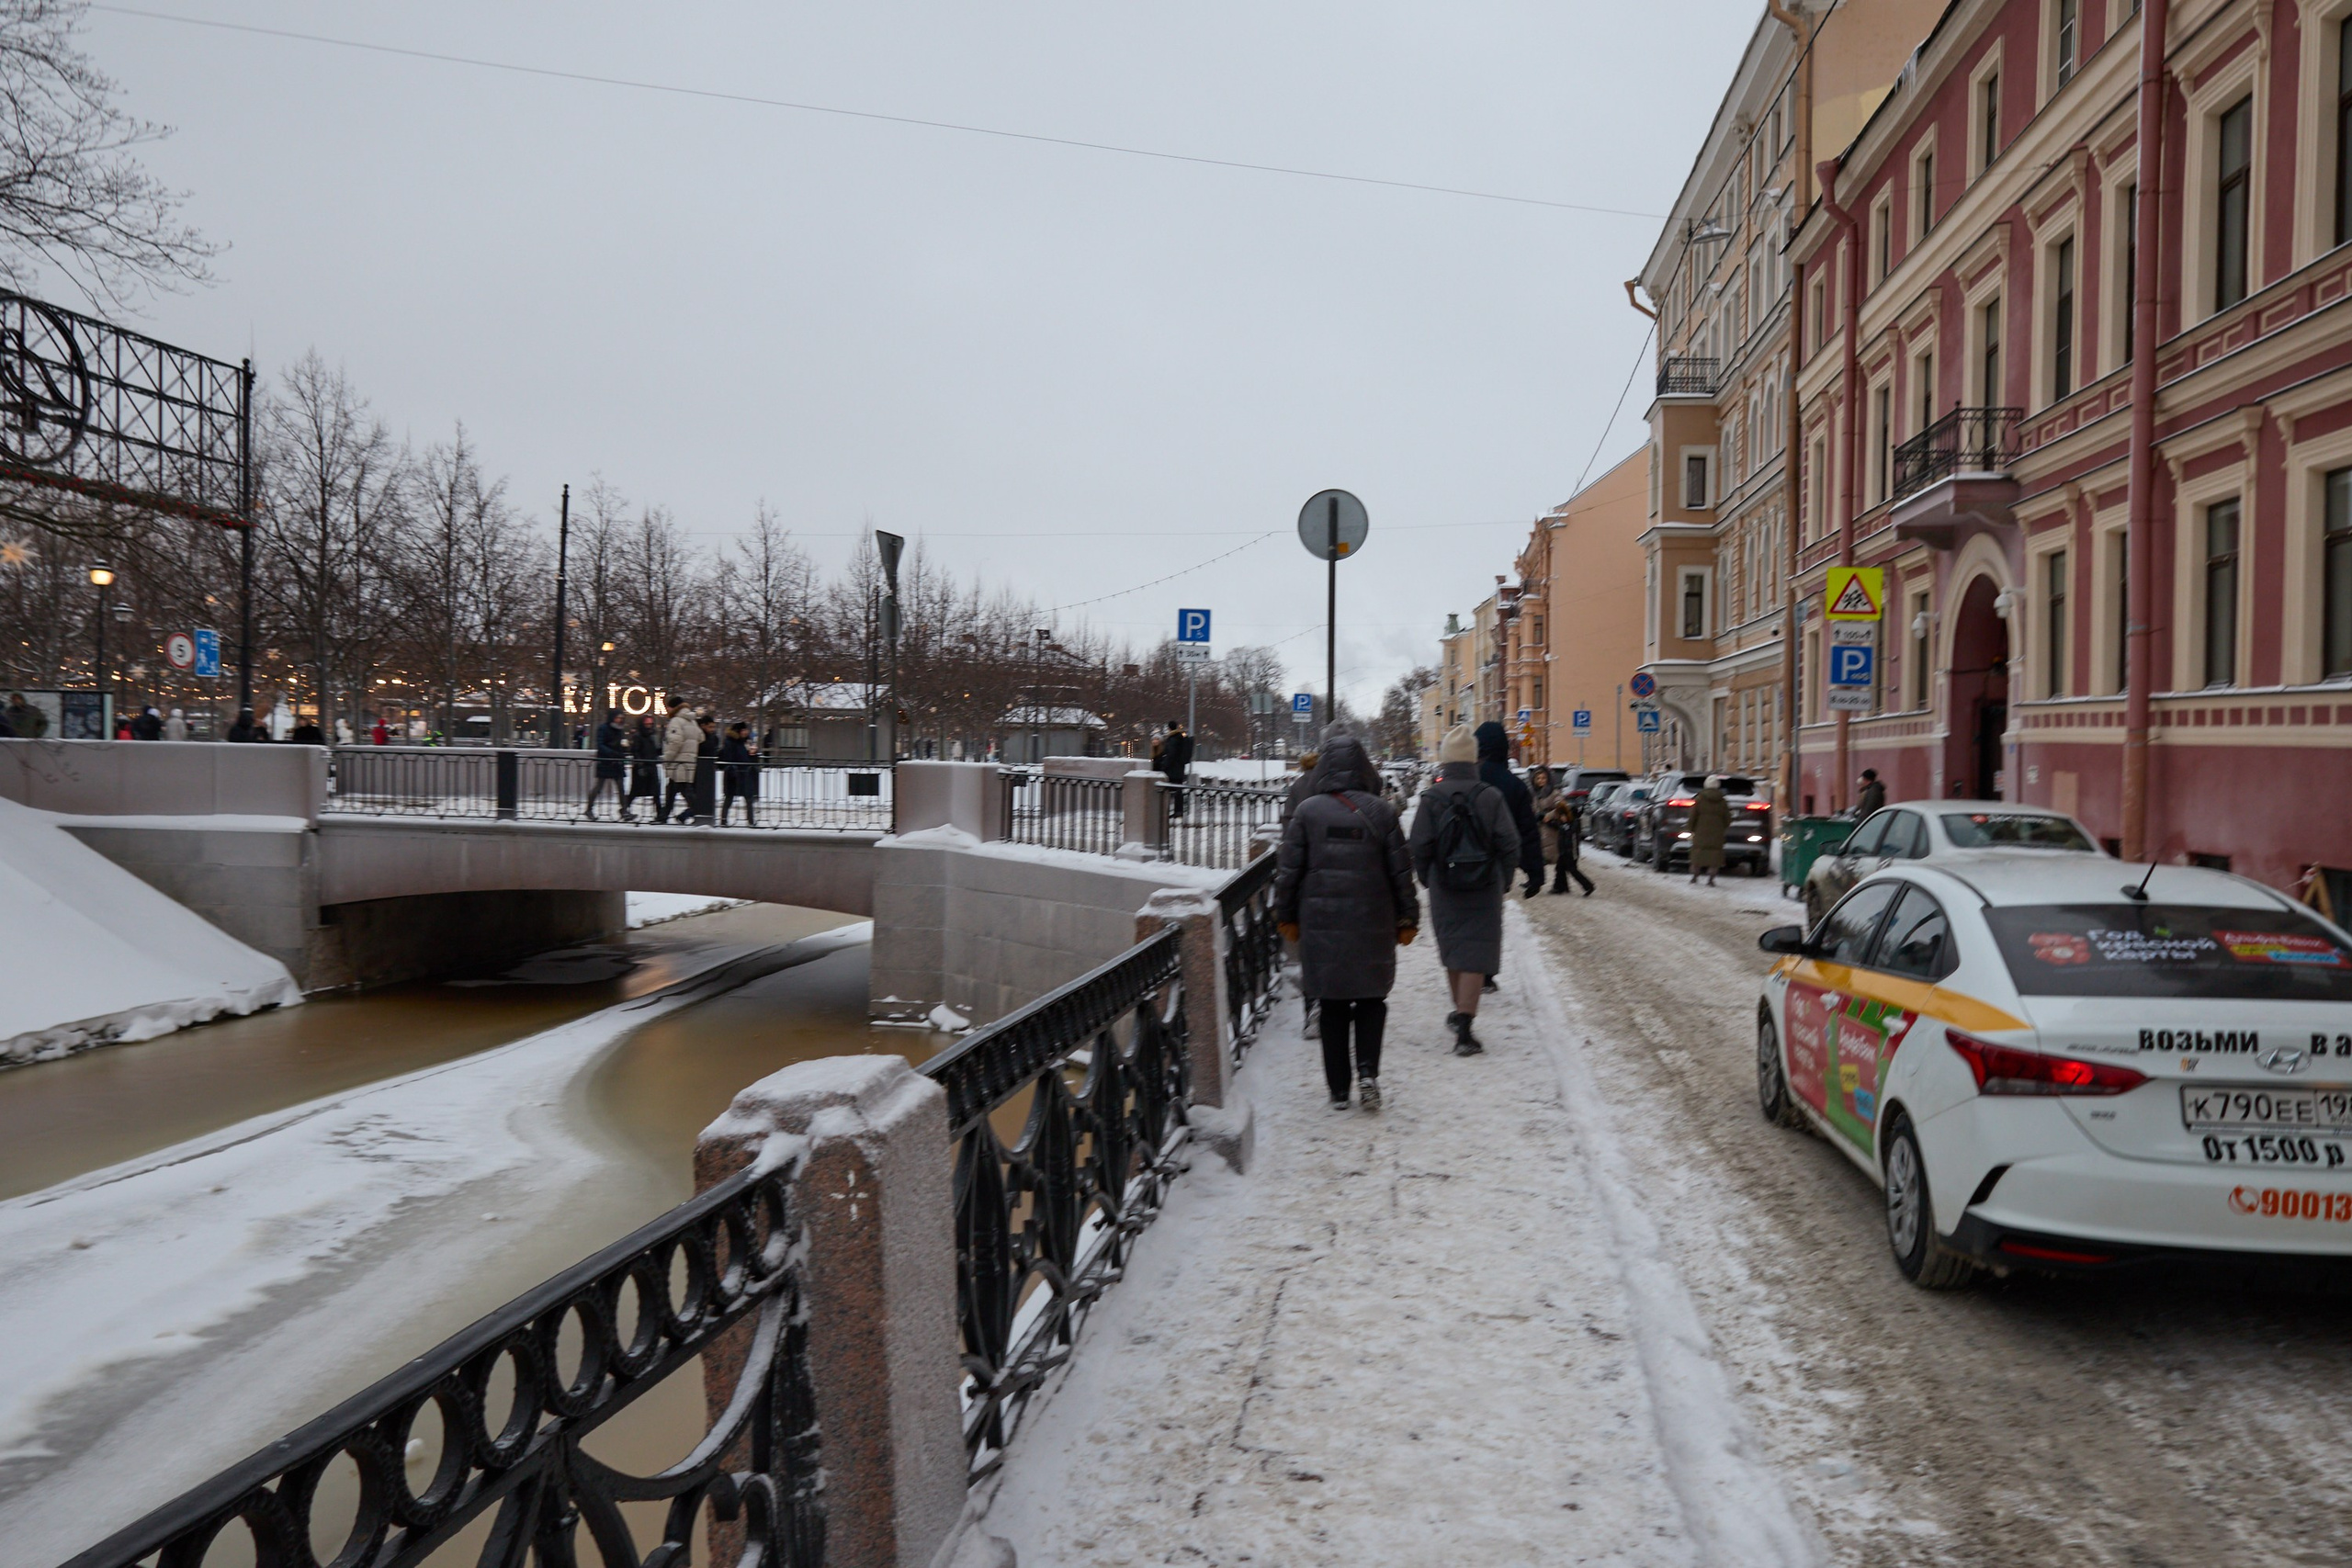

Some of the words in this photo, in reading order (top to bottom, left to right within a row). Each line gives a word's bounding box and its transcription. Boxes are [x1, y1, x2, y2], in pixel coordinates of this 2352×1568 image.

[1186, 613, 1205, 638] P
[176, 644, 186, 658] 5
[1841, 649, 1866, 681] P
[1297, 695, 1308, 710] P
[2320, 1094, 2352, 1117] 19
[2243, 1134, 2320, 1164] 1500
[2324, 1143, 2345, 1168] р
[2261, 1187, 2352, 1224] 90013
